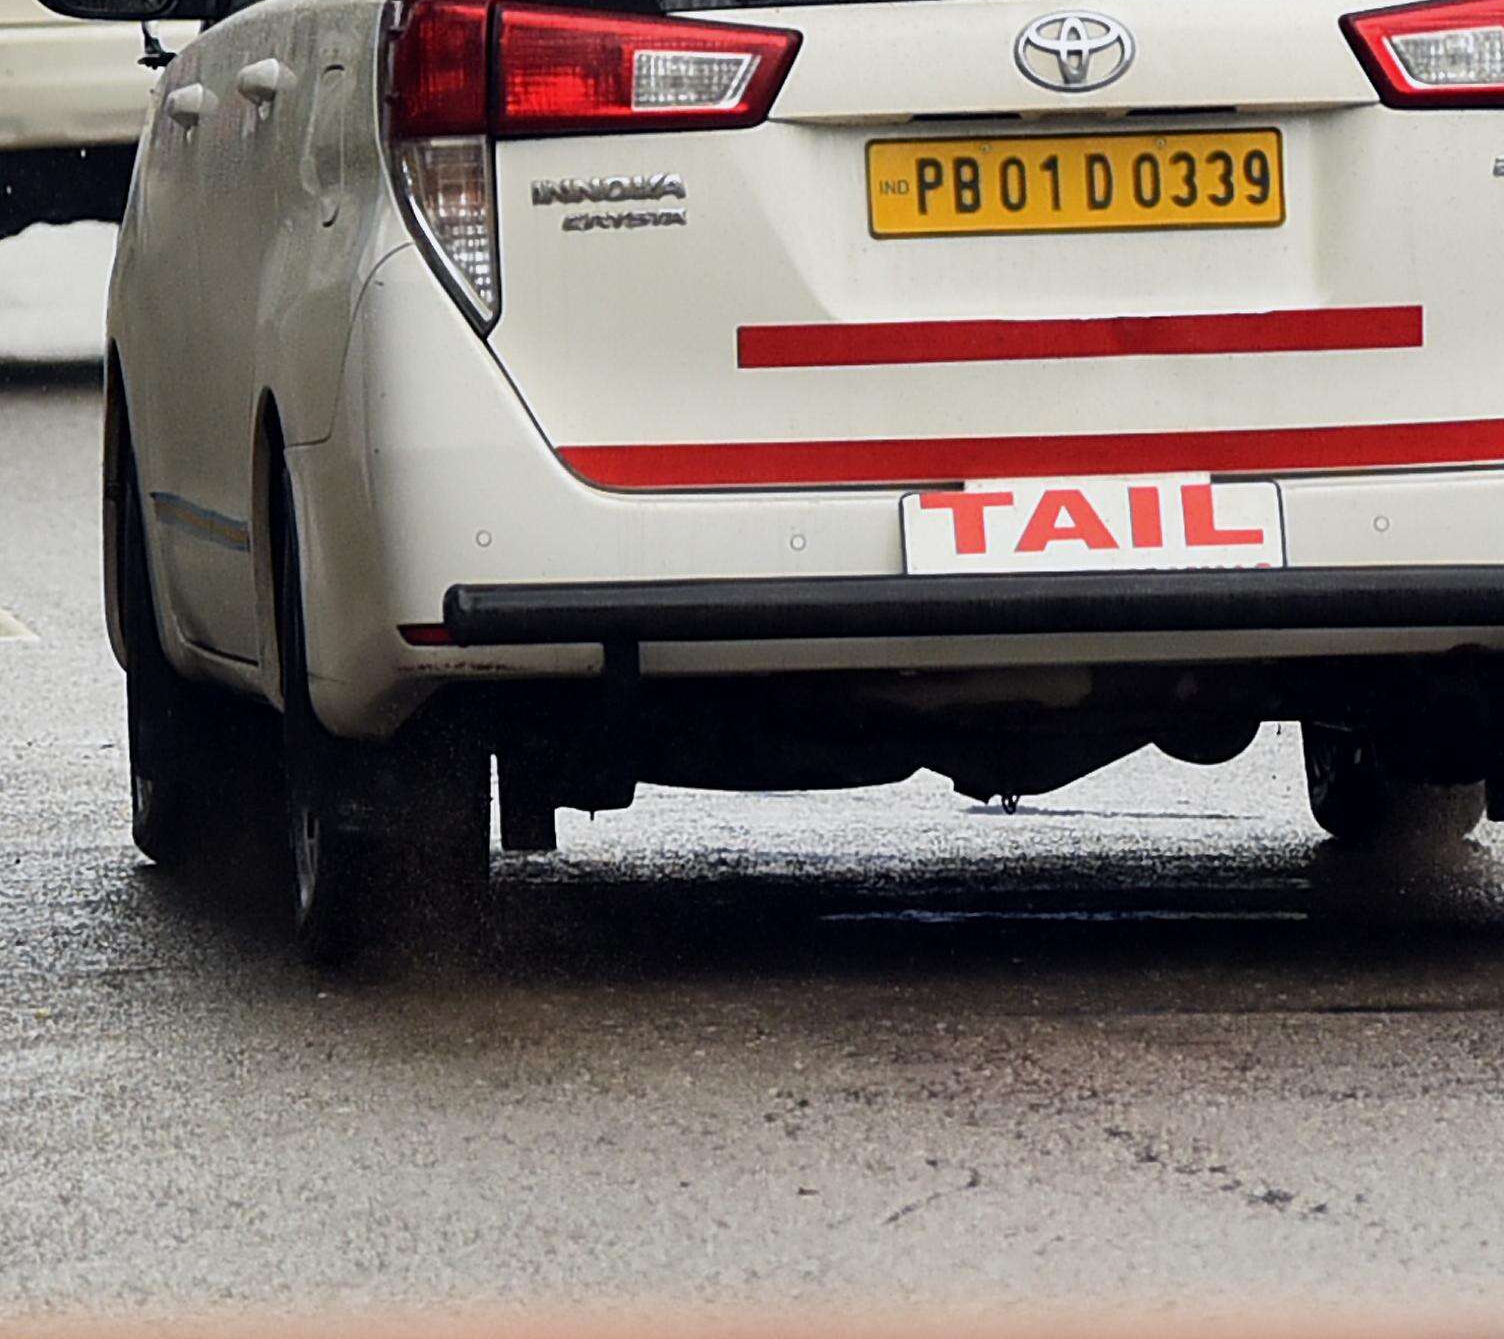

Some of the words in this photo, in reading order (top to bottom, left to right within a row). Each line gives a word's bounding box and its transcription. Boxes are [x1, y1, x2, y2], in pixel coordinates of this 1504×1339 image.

[879, 179, 909, 196] IND
[914, 156, 982, 216] PB
[998, 154, 1062, 213] 01
[1083, 152, 1115, 212] D
[1133, 148, 1272, 209] 0339
[919, 483, 1265, 555] TAIL
